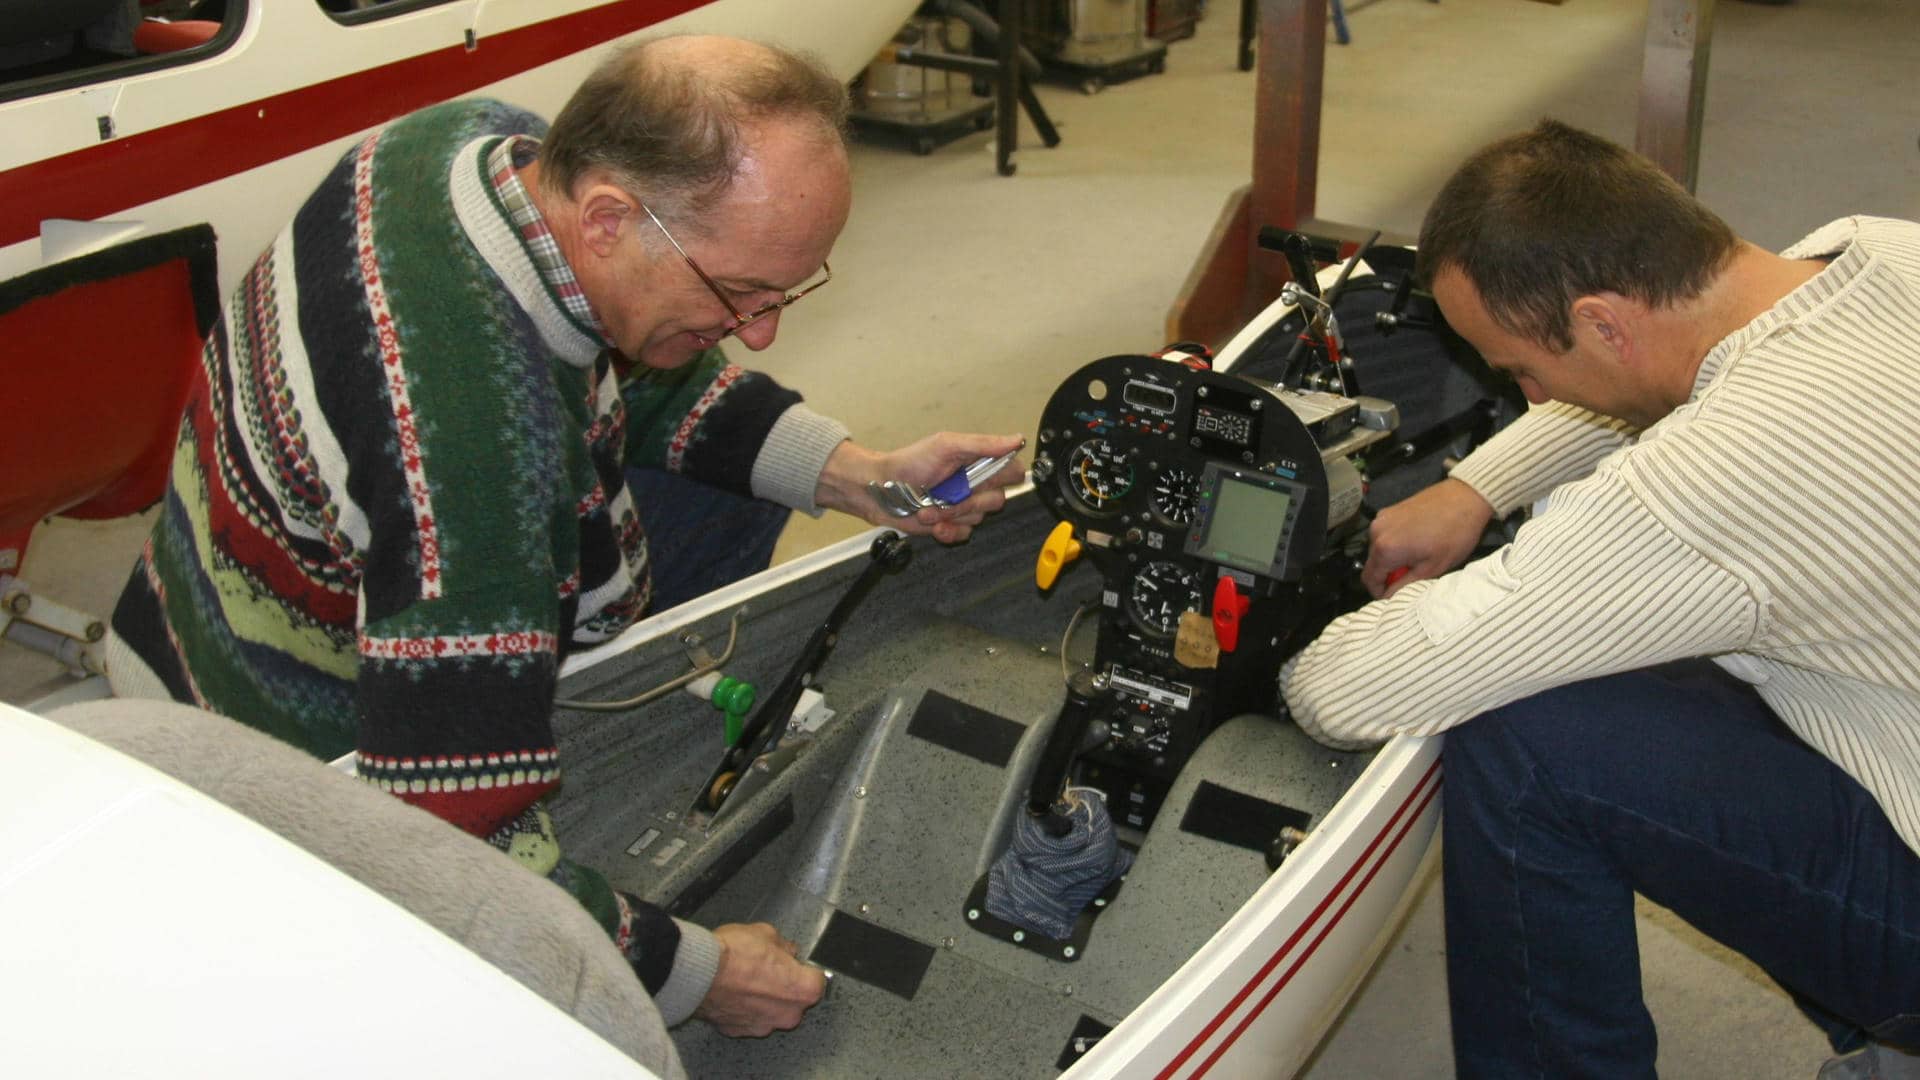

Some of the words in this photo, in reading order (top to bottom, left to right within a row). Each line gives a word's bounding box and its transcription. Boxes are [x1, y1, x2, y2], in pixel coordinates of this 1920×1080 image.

[1140, 594, 1147, 602] 2
[1190, 591, 1196, 599] 7
[1162, 616, 1168, 625] 0
